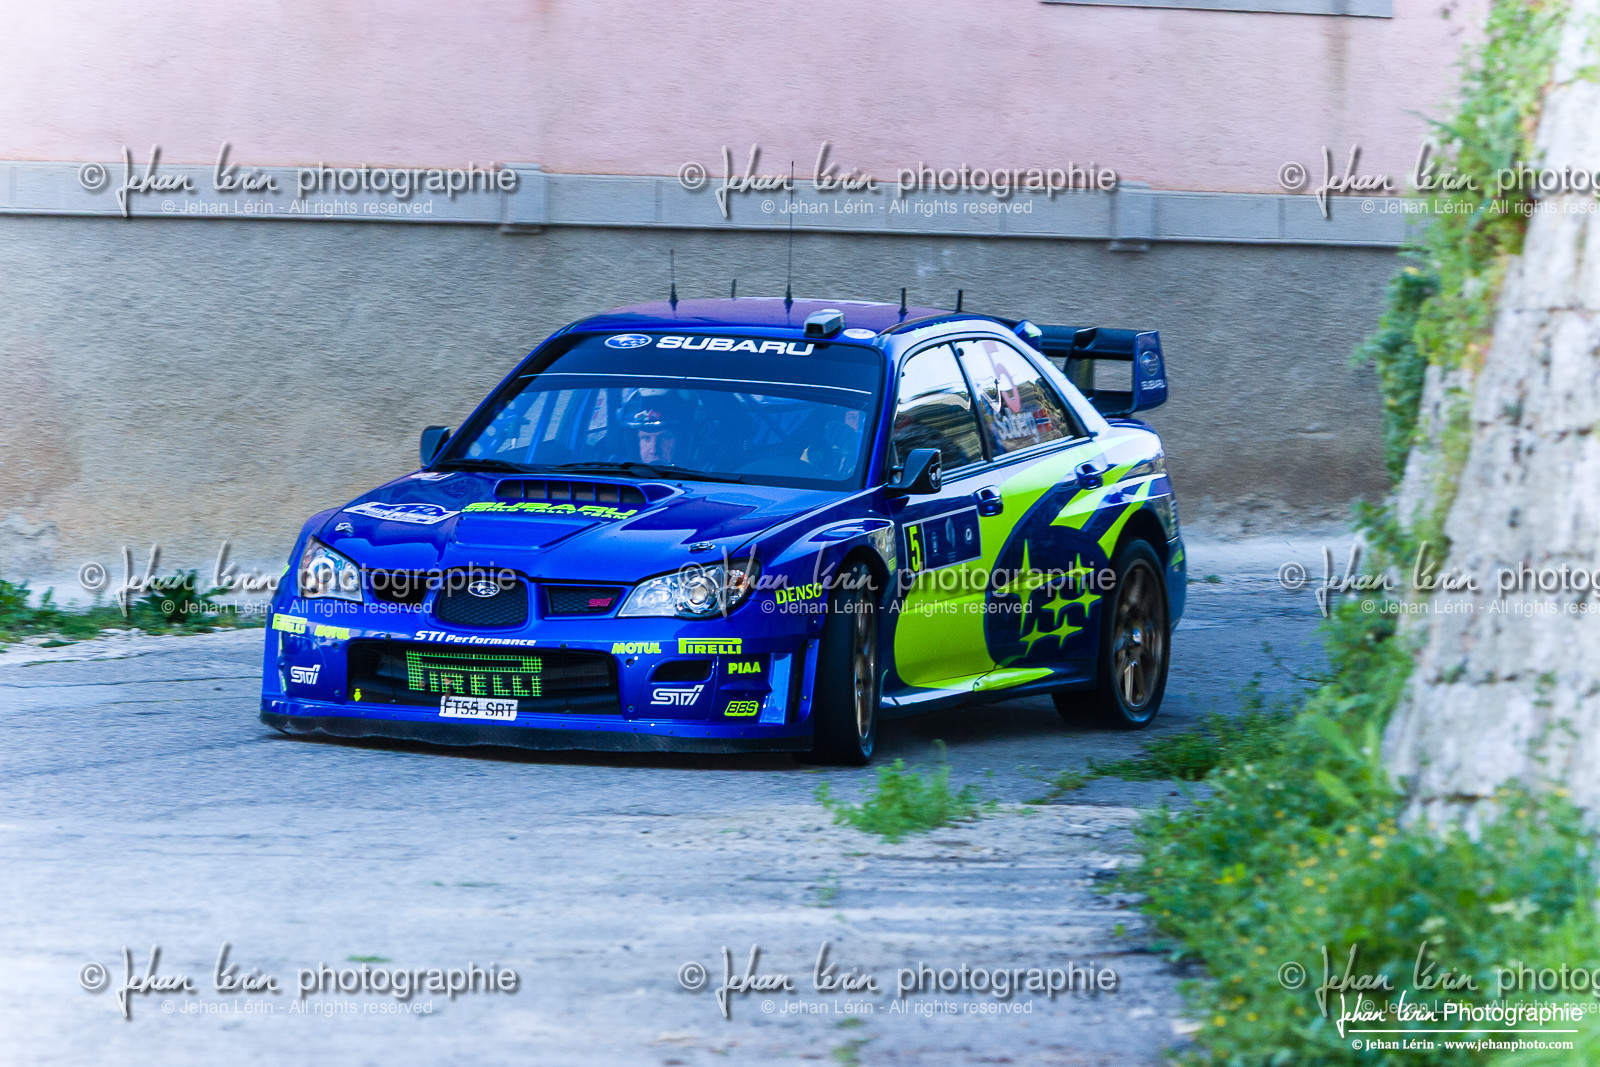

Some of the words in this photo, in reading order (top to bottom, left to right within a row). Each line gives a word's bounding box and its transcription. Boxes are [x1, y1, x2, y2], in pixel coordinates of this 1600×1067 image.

[656, 336, 814, 356] SUBARU
[463, 502, 638, 516] SUBARU
[909, 525, 920, 572] 5
[775, 582, 823, 604] DENSO
[414, 630, 446, 642] STI
[445, 634, 536, 646] Performance
[678, 638, 742, 654] PIRELLI
[611, 642, 661, 654] MOTUL
[406, 650, 541, 696] PIRELLI
[728, 661, 761, 674] PIAA
[485, 702, 515, 717] SRT
[725, 702, 758, 715] BBS
